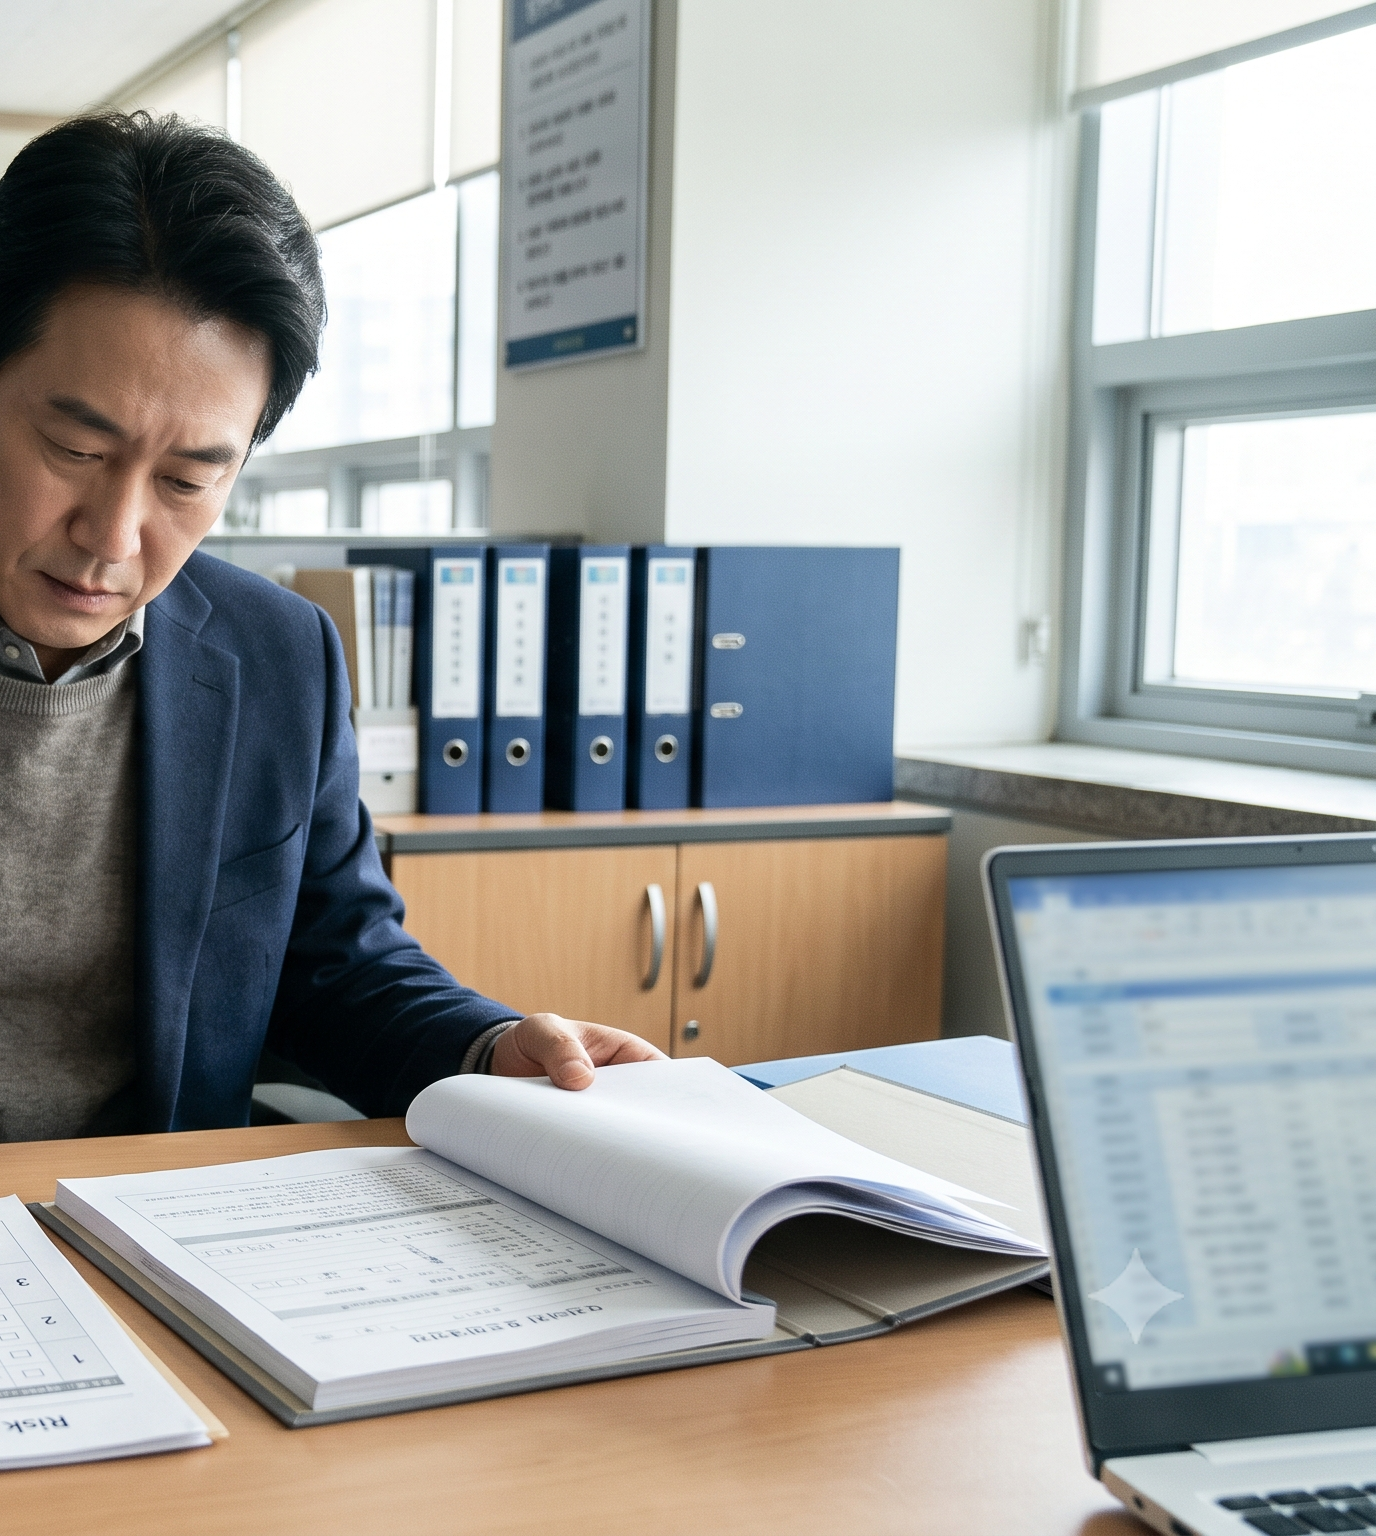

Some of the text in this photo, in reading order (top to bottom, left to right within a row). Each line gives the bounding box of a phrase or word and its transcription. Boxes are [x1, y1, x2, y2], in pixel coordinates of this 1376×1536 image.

[15, 1277, 30, 1287] 3
[40, 1315, 57, 1325] 2
[71, 1353, 85, 1364] 1
[6, 1414, 70, 1432] Risk
